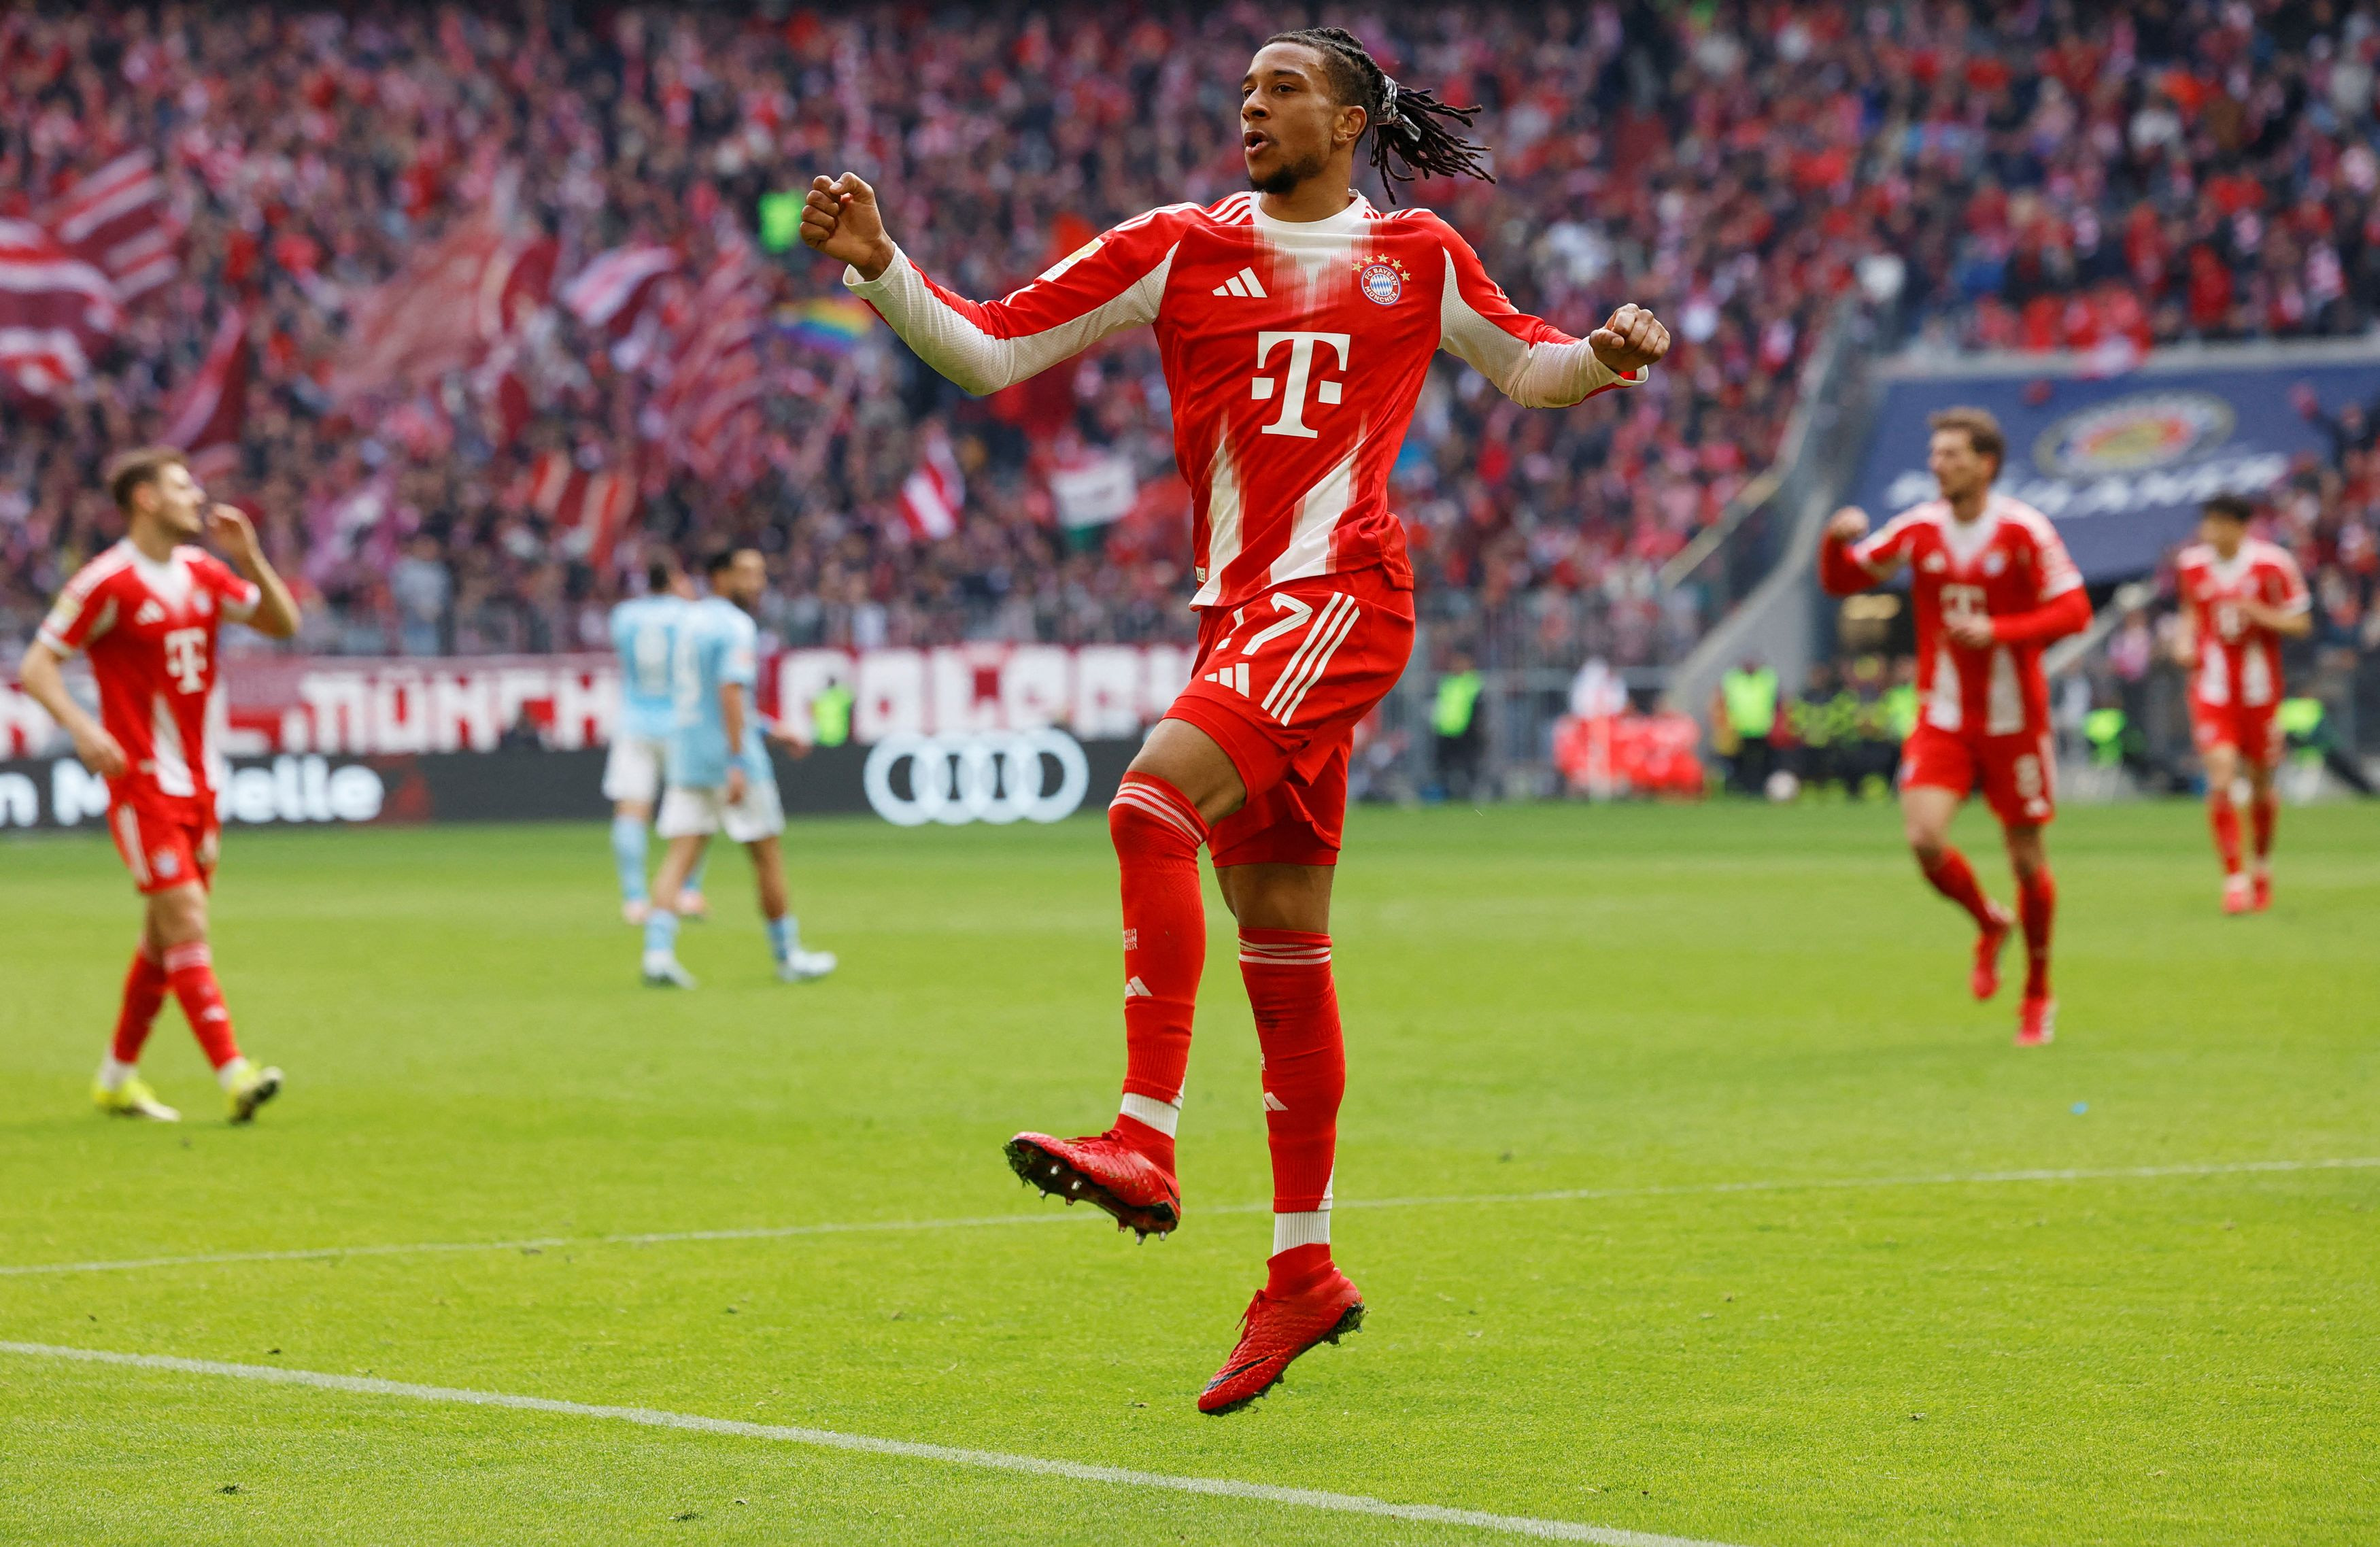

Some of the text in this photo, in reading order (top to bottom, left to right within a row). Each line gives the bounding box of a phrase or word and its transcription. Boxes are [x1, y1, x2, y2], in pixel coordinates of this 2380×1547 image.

[1364, 268, 1398, 286] FC BAYERN
[1364, 286, 1397, 303] MÜNCHEN
[1251, 331, 1351, 439] T
[164, 626, 208, 695] T
